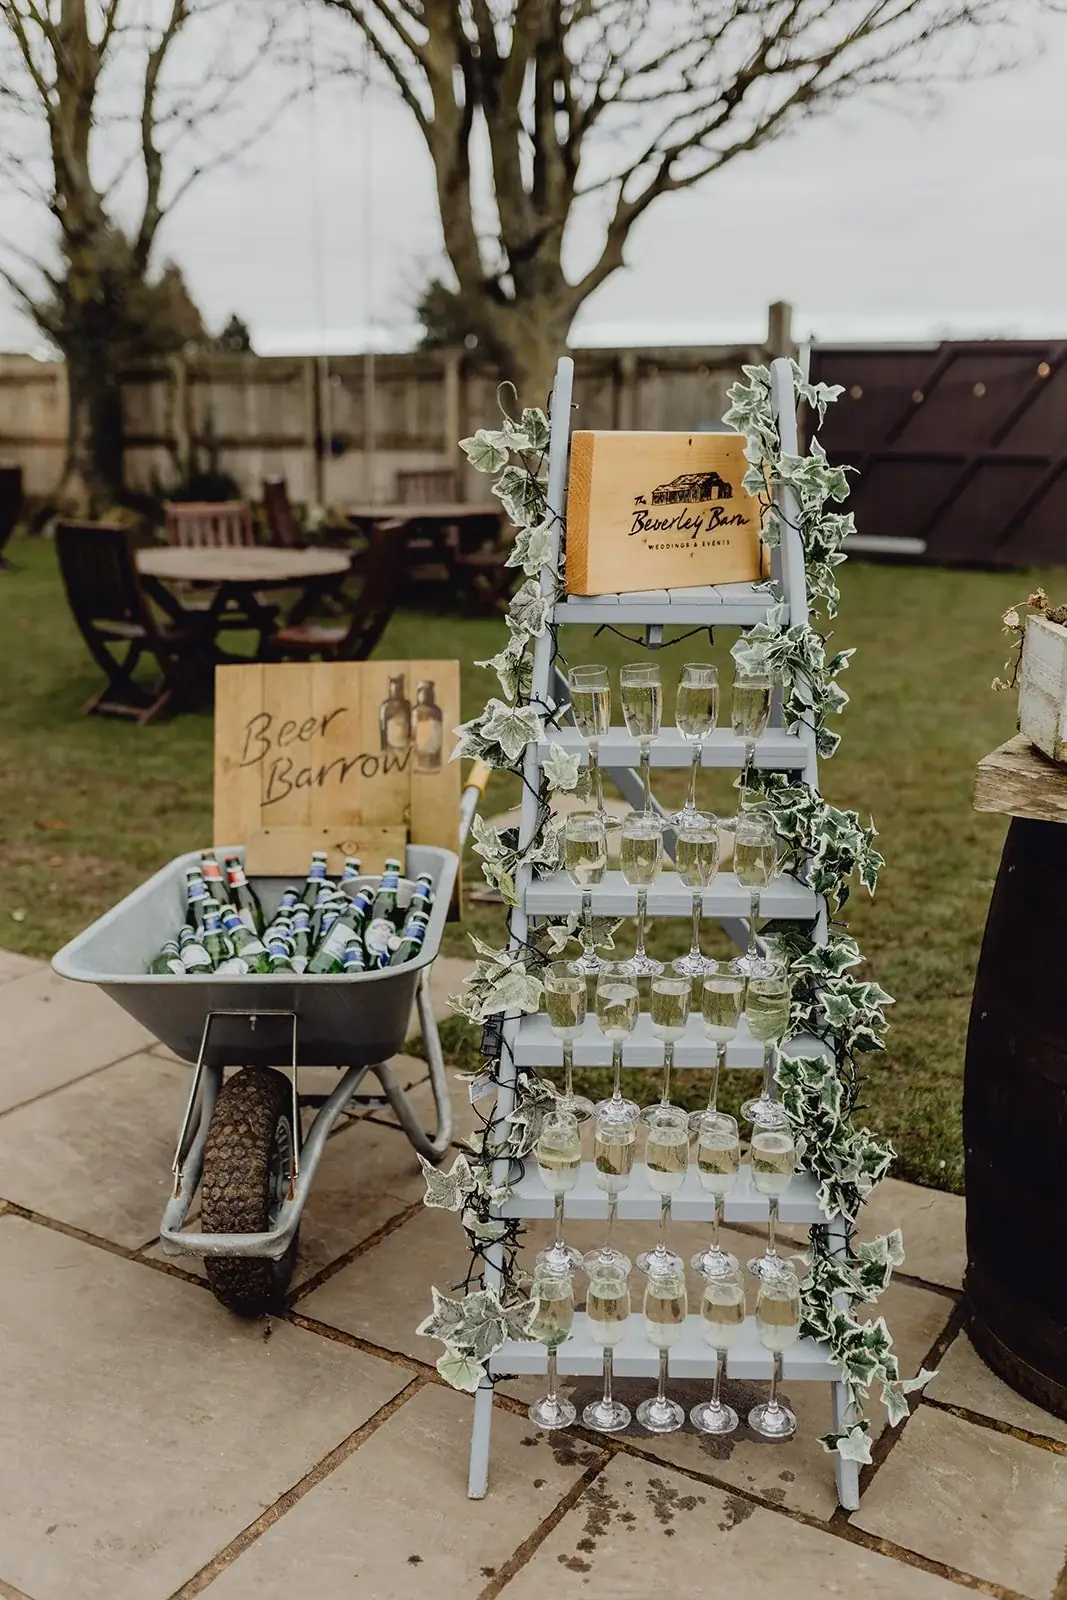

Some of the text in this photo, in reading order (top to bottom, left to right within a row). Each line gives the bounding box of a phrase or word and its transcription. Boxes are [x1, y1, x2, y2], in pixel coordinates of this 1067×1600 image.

[634, 495, 647, 506] The
[628, 506, 750, 539] Beverley Barn
[648, 542, 690, 550] WEDDINGS
[702, 540, 731, 548] EVENTS
[239, 707, 349, 768] Beer
[260, 745, 415, 808] Barrow
